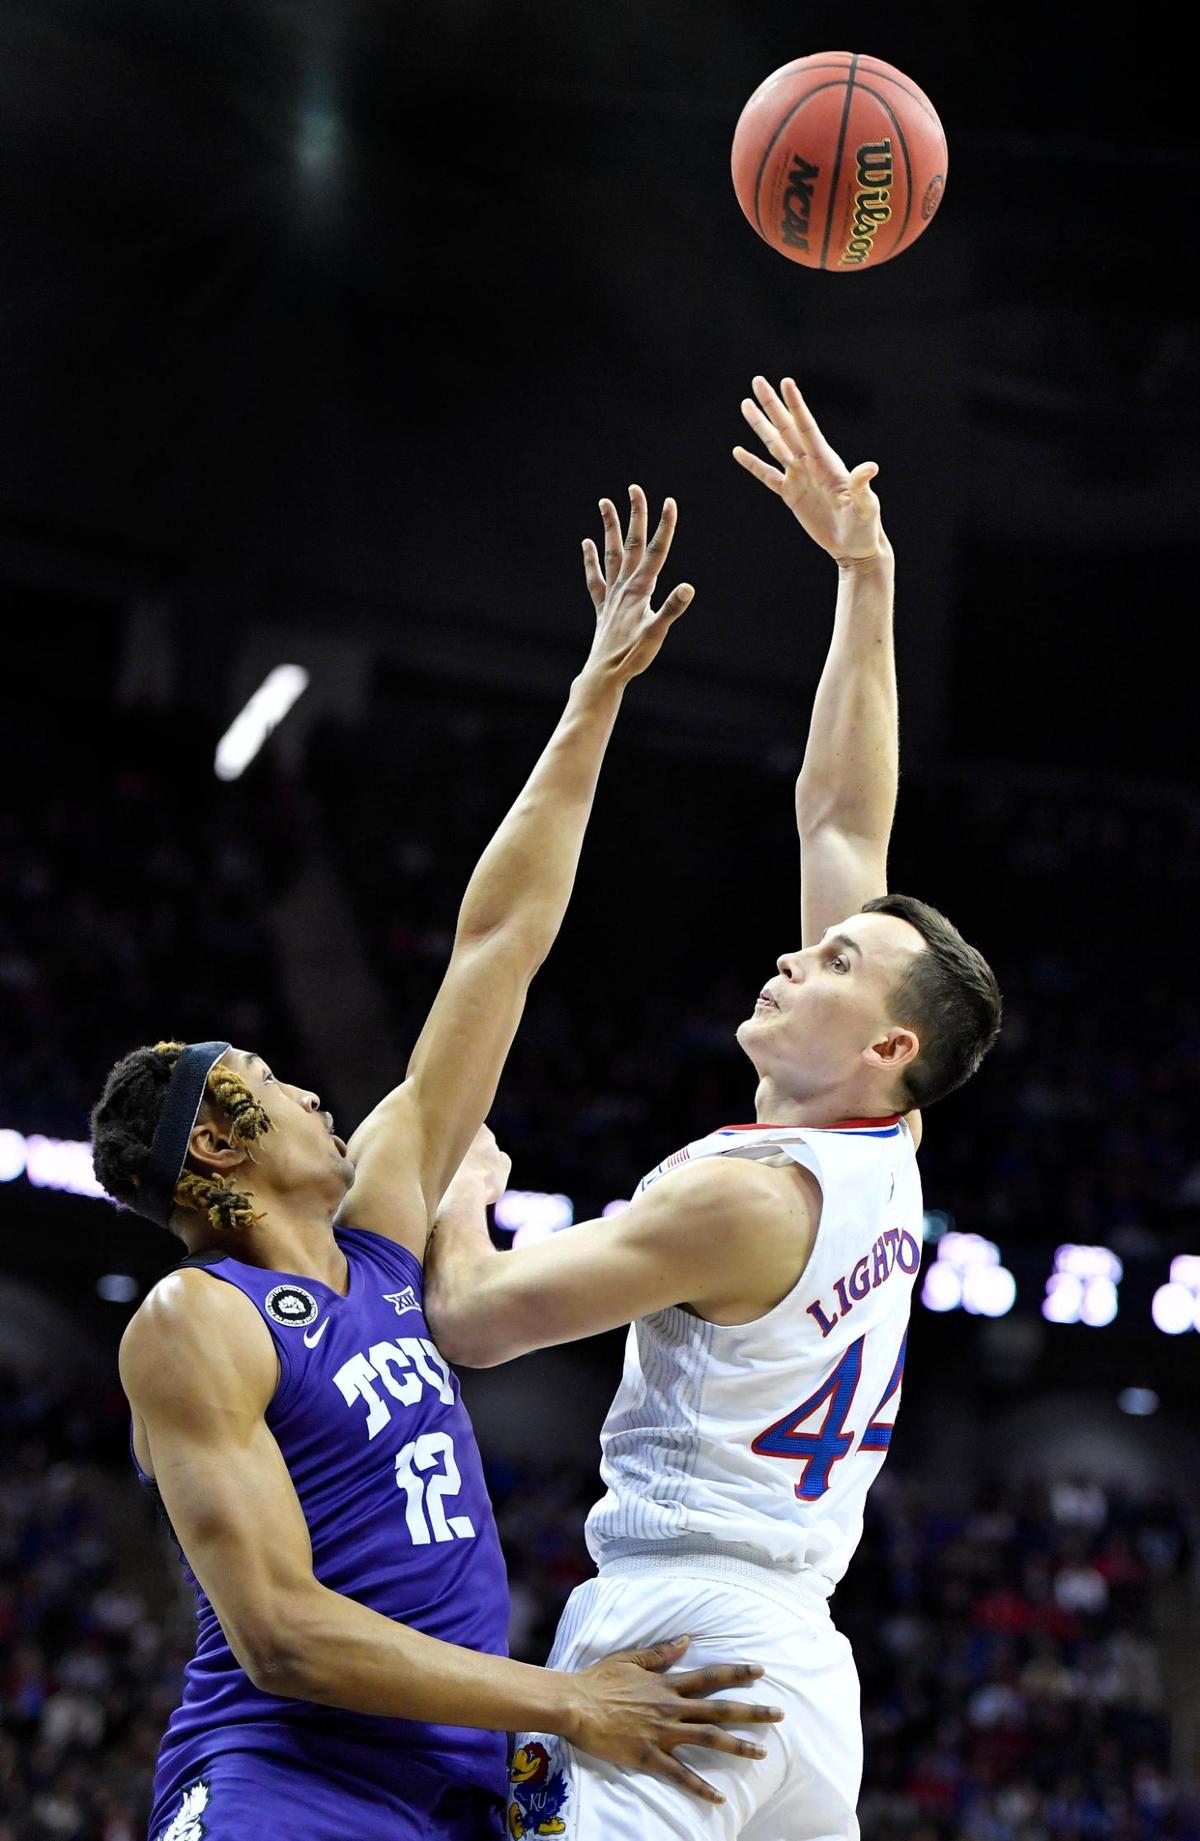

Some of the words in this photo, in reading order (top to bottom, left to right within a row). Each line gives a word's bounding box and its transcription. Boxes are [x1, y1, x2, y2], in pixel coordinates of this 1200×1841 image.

[838, 137, 894, 267] Wilson
[806, 1227, 921, 1328] LIGHTO
[332, 1337, 455, 1441] TCU
[395, 1431, 476, 1546] 12
[529, 1791, 548, 1812] KU
